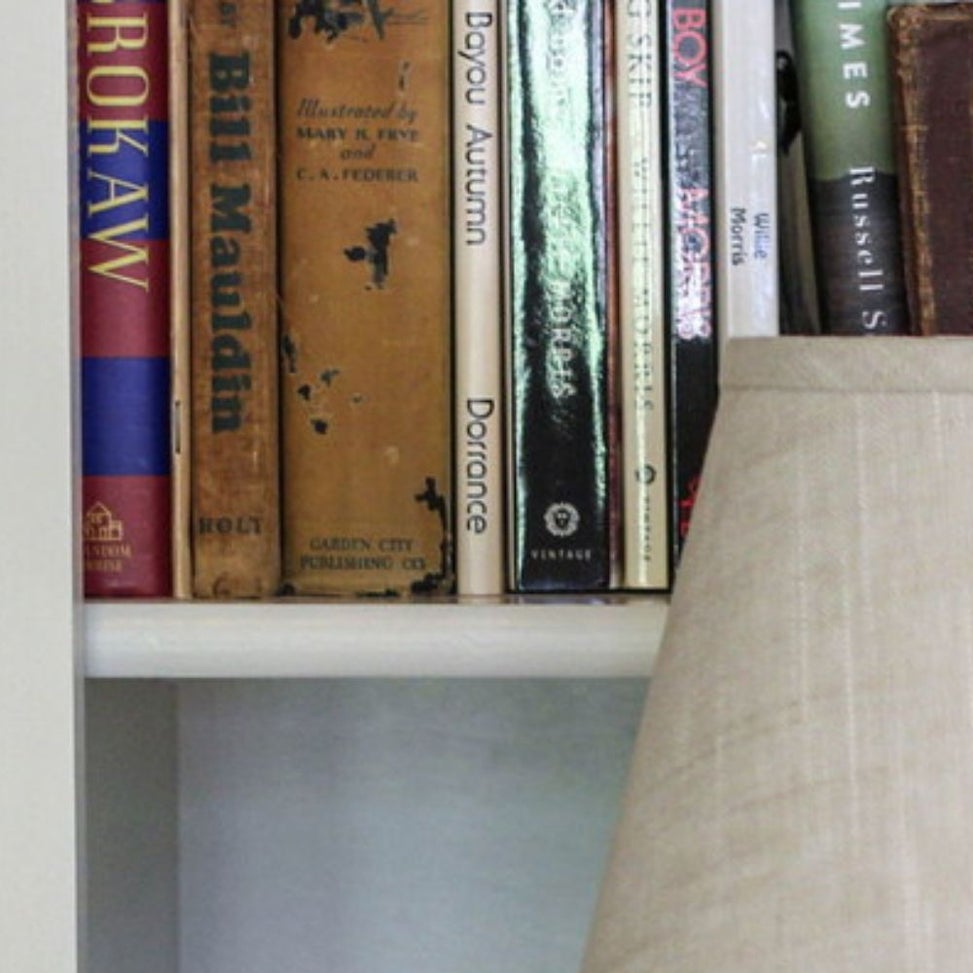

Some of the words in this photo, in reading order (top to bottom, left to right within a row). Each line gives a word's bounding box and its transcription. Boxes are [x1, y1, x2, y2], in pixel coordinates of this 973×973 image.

[458, 10, 493, 107] Bayou
[627, 33, 652, 108] SKIP
[673, 7, 708, 88] BOY
[209, 52, 250, 164] Bill
[296, 98, 394, 119] Illustrated
[398, 103, 418, 126] by
[296, 127, 346, 140] MARY
[87, 0, 149, 292] ROKAW
[340, 143, 376, 160] and
[465, 123, 493, 246] Autumn
[729, 207, 748, 267] Morris
[753, 212, 769, 259] Willie
[851, 167, 884, 292] Russell
[210, 183, 252, 434] Mauldin
[547, 279, 577, 399] MORRIS
[466, 398, 494, 535] Dorrance
[199, 517, 263, 535] HOLT
[300, 555, 393, 570] PUBLISHING
[309, 536, 371, 551] GARDEN
[378, 537, 413, 552] CITY
[531, 549, 592, 560] VINTAGE
